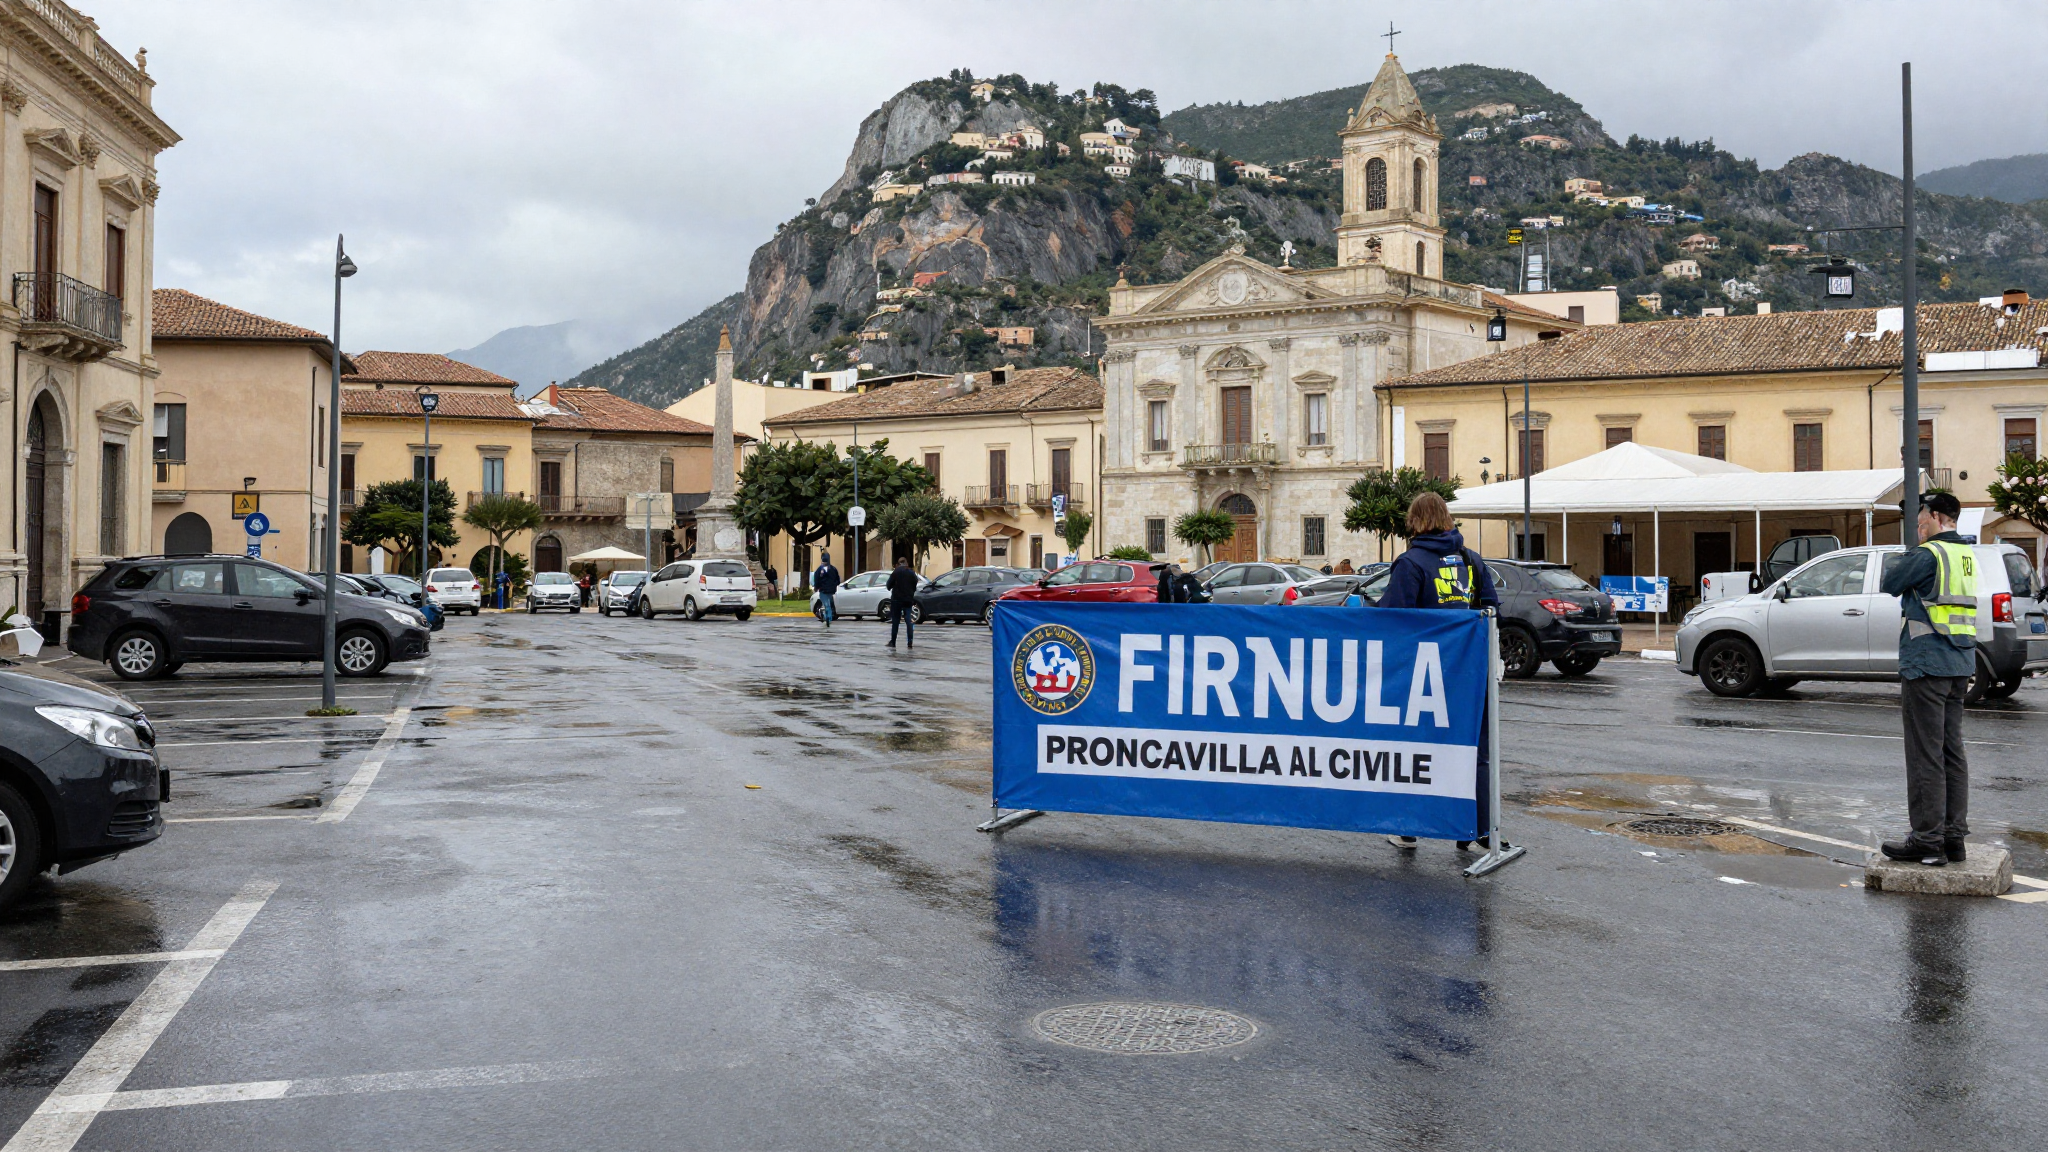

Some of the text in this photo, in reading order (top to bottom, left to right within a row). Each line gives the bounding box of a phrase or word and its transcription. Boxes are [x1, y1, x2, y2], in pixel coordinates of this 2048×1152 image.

[1118, 633, 1450, 728] FIRNULA
[1046, 735, 1432, 785] PRONCAVILLA AL CIVILE
